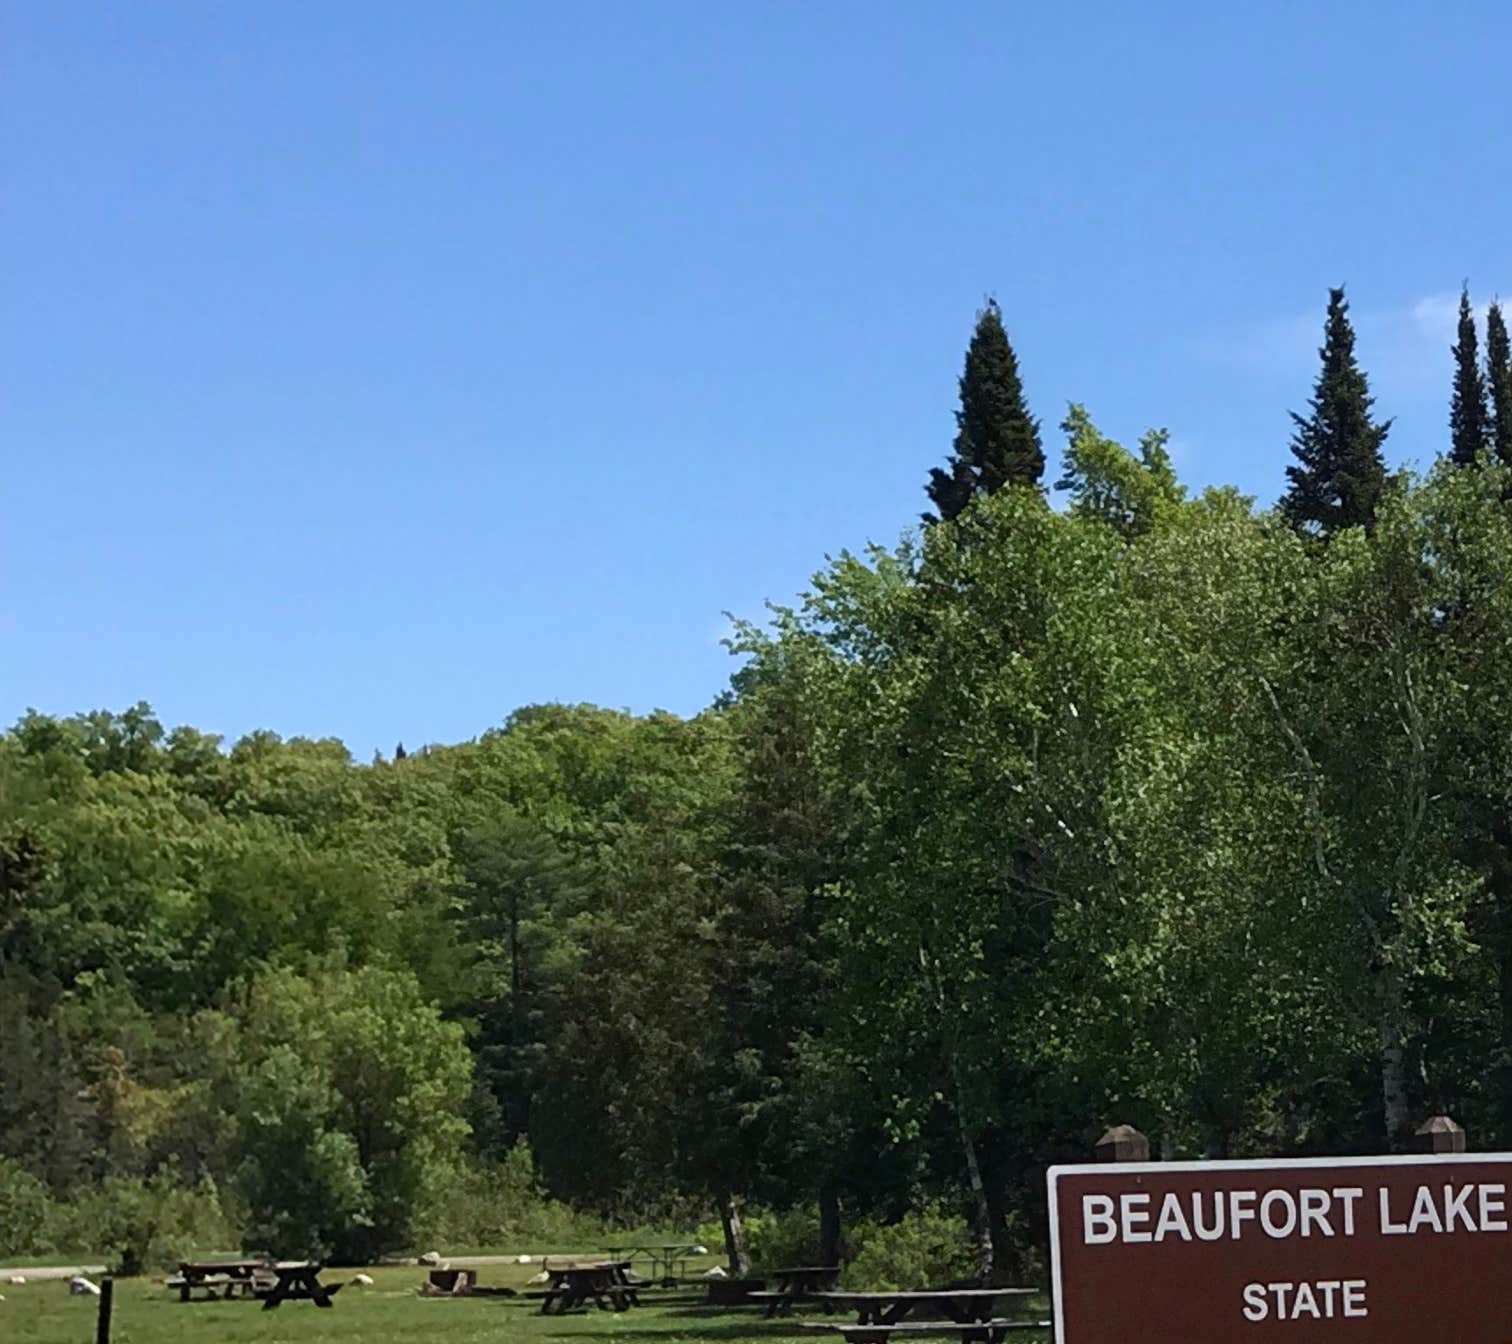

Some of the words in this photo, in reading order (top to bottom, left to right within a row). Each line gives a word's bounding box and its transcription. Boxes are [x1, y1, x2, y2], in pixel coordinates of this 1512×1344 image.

[1083, 1188, 1362, 1244] BEAUFORT
[1380, 1184, 1507, 1234] LAKE
[1243, 1280, 1367, 1321] STATE
